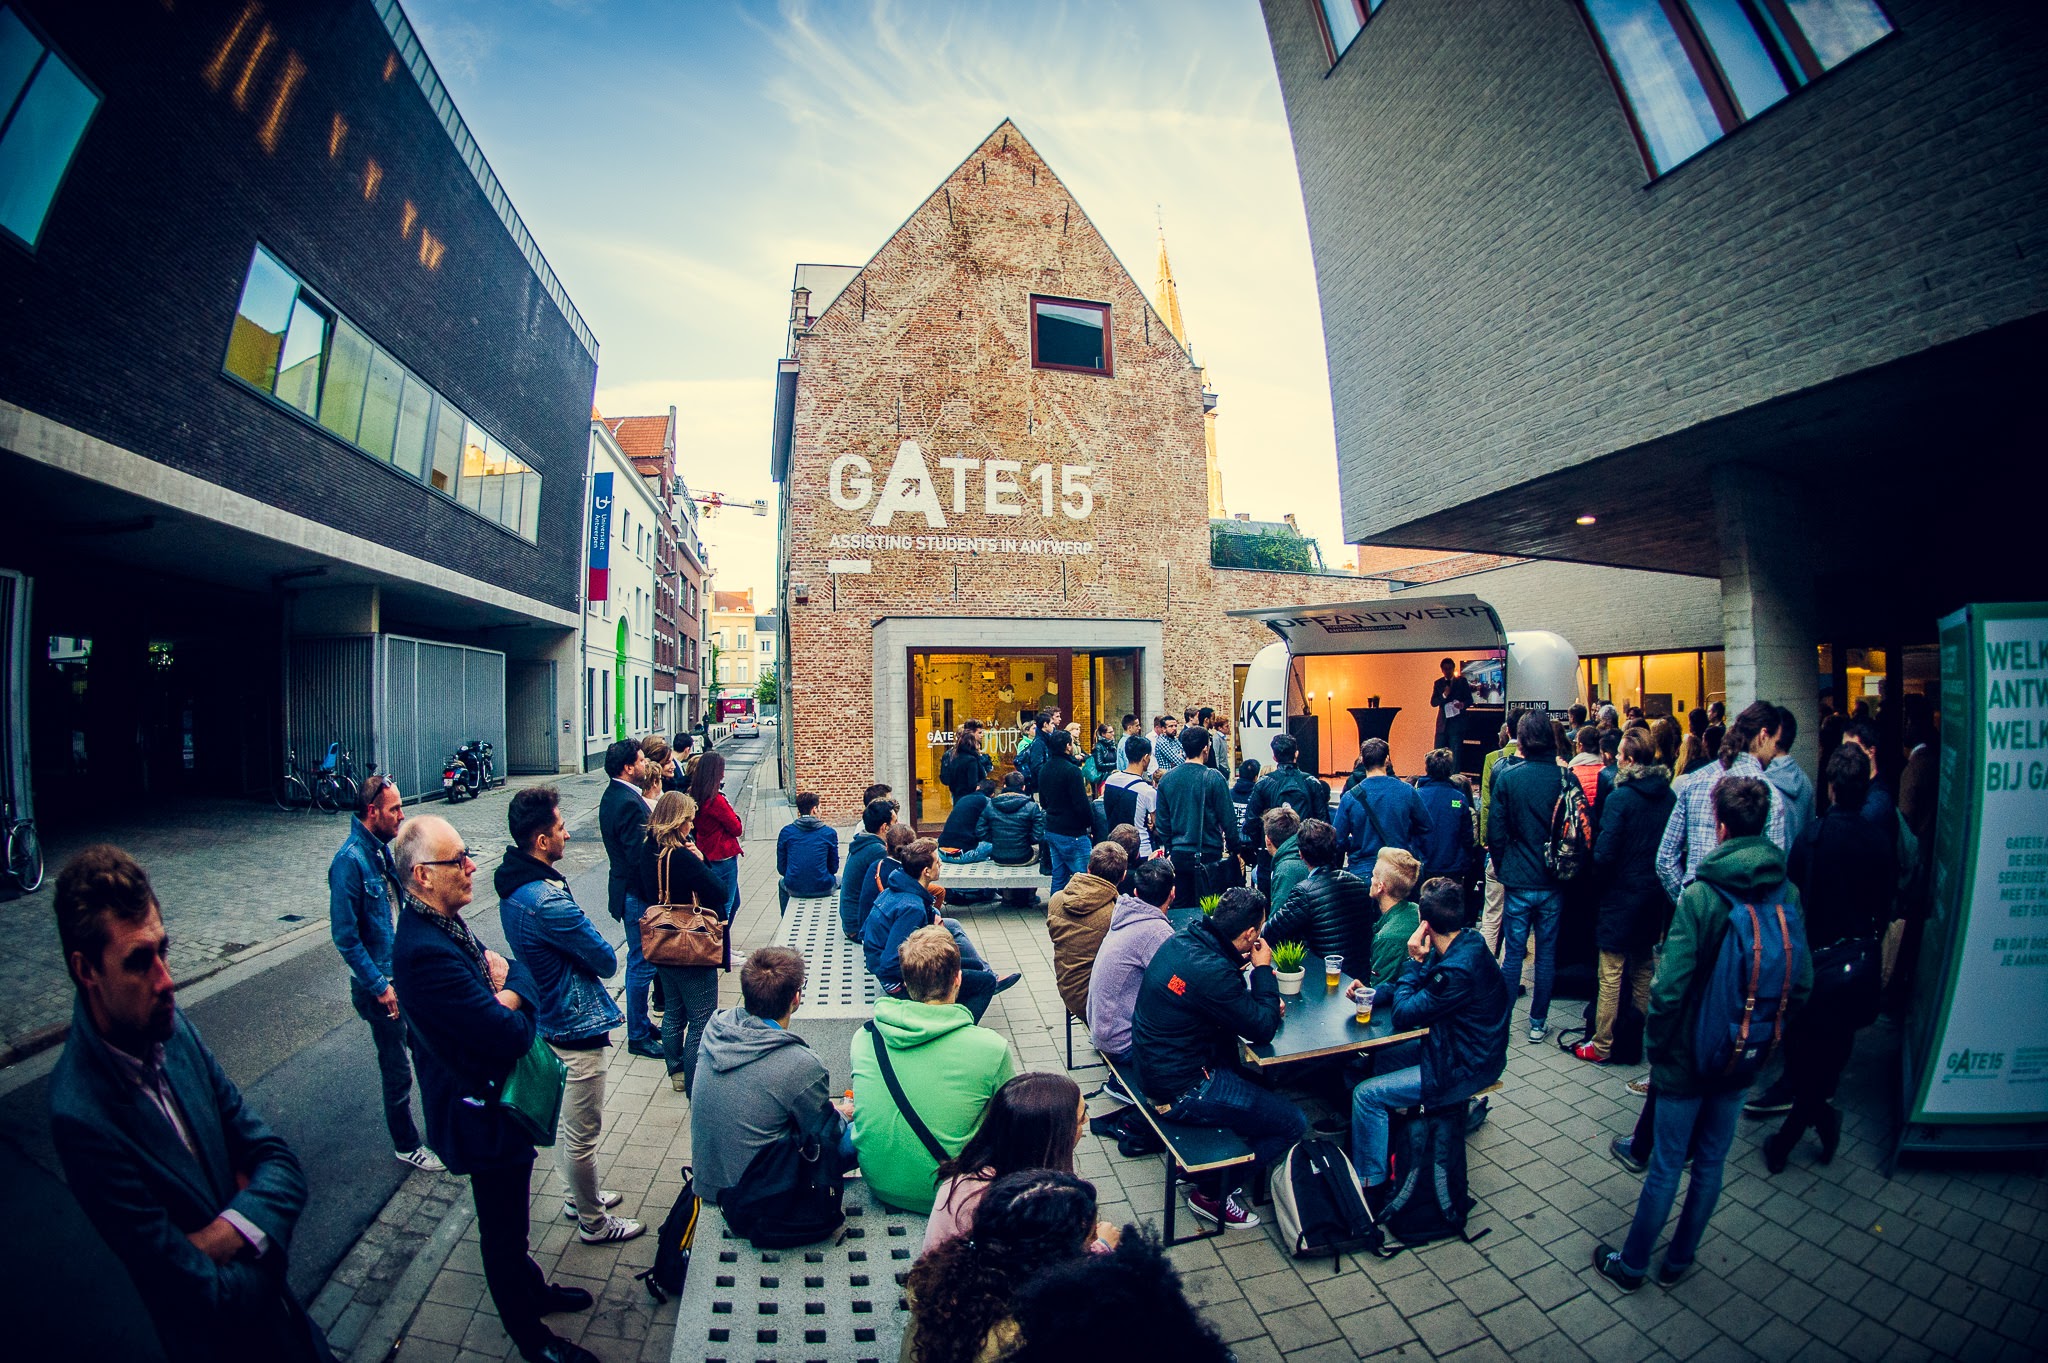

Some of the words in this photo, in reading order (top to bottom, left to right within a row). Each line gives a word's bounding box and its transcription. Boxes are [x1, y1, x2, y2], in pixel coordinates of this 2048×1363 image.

[829, 440, 1093, 528] GATE15
[592, 514, 601, 549] Antwerpen
[599, 514, 607, 551] Universiteit
[829, 534, 913, 550] ASSISTING
[916, 535, 998, 552] STUDENTS
[1000, 539, 1016, 553] IN
[1020, 539, 1093, 554] ANTWERP
[1987, 762, 2022, 791] BIJ
[1947, 1048, 2004, 1073] GATE15
